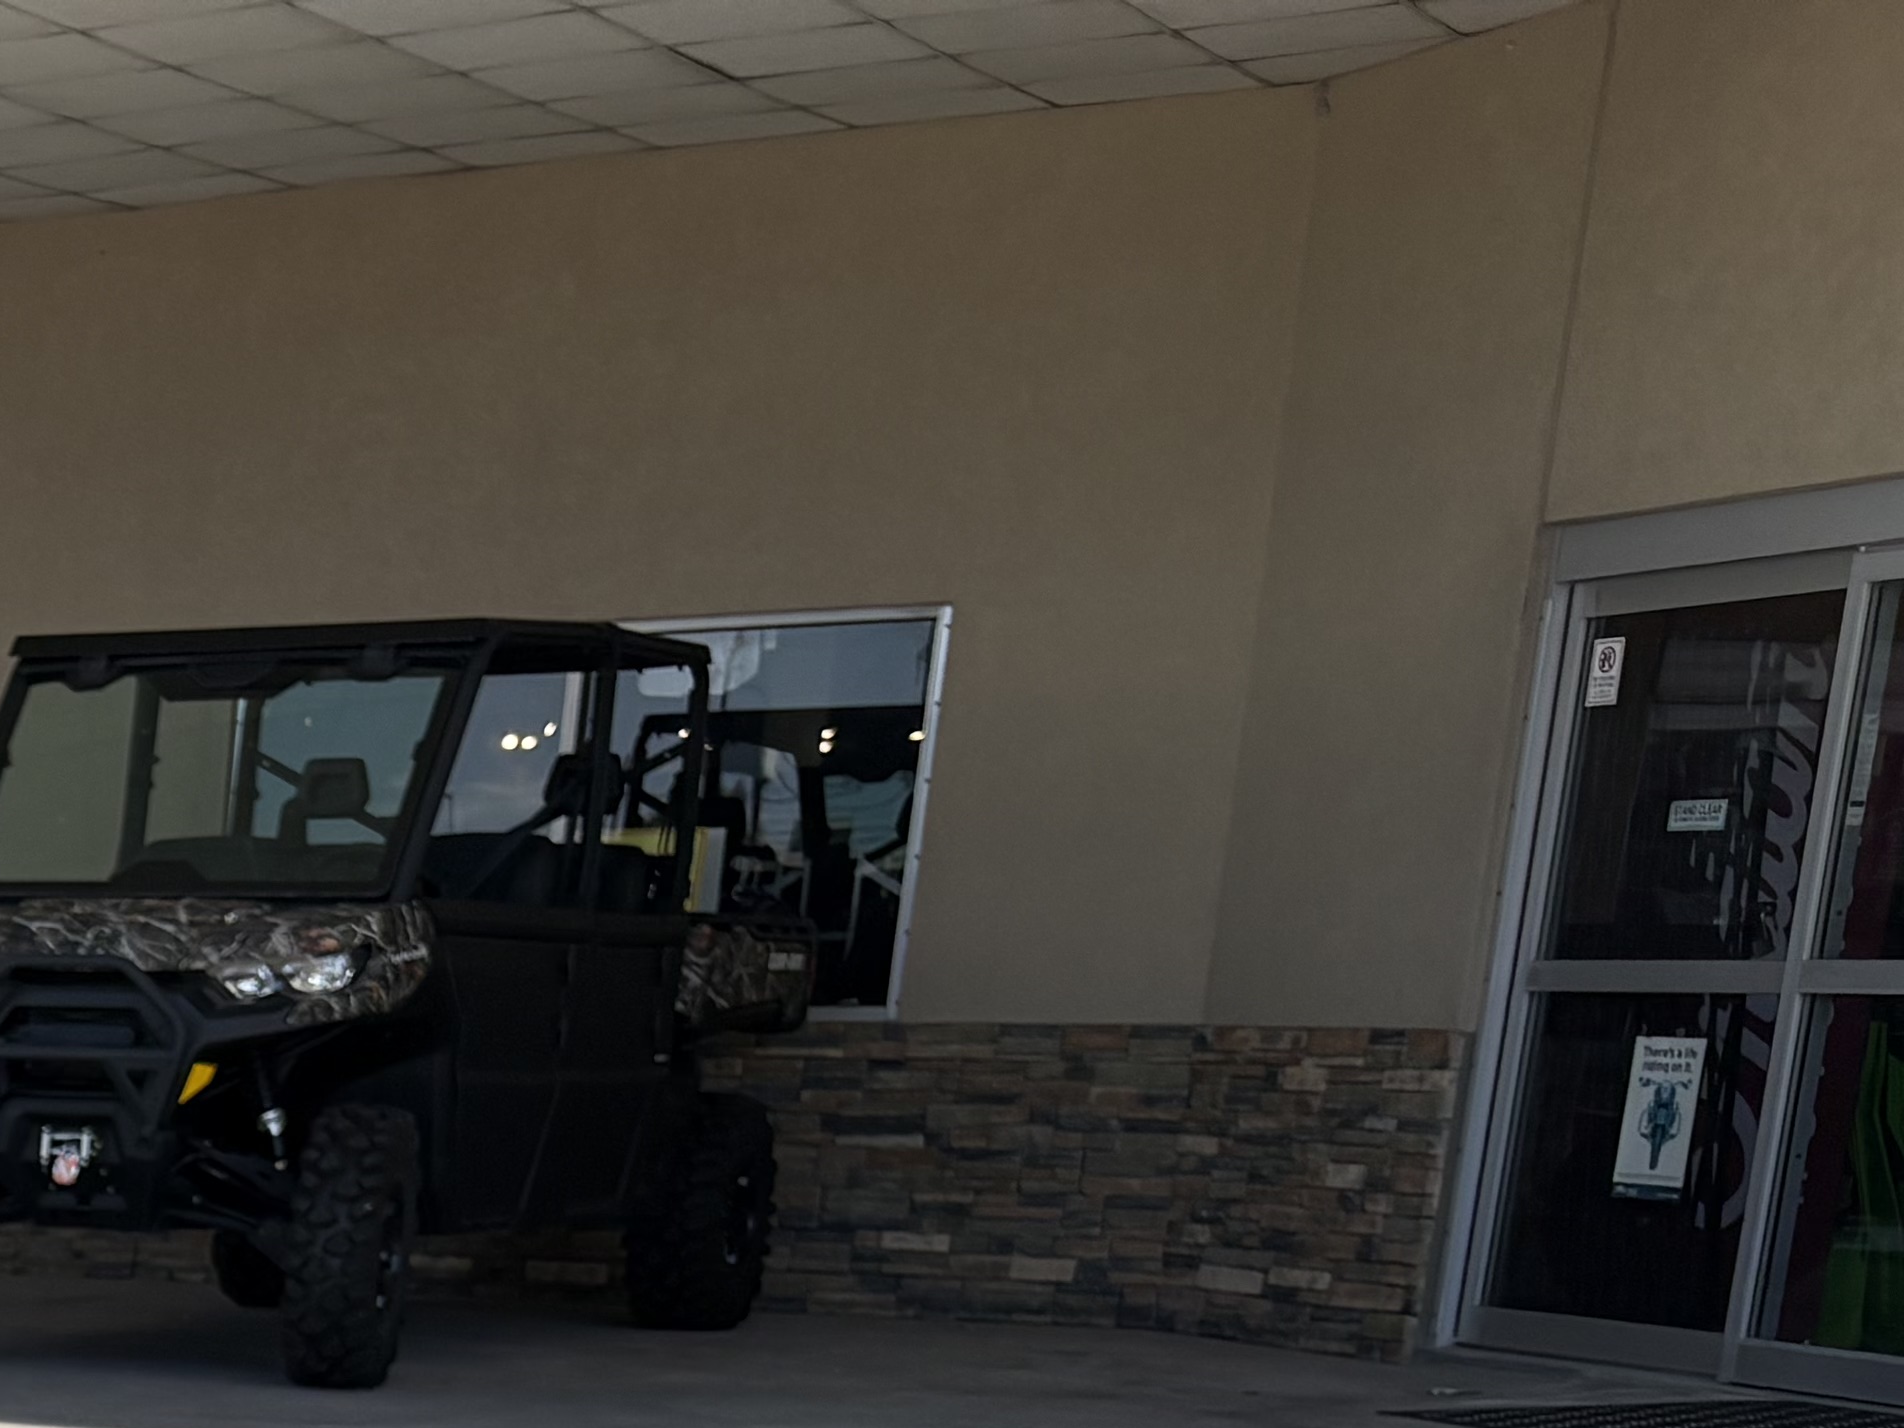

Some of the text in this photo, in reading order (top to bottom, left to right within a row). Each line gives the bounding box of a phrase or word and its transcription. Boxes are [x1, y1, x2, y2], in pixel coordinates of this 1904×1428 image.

[1643, 1046, 1675, 1059] There's
[1684, 1046, 1698, 1059] life
[1642, 1060, 1669, 1073] riding
[1671, 1062, 1683, 1073] on
